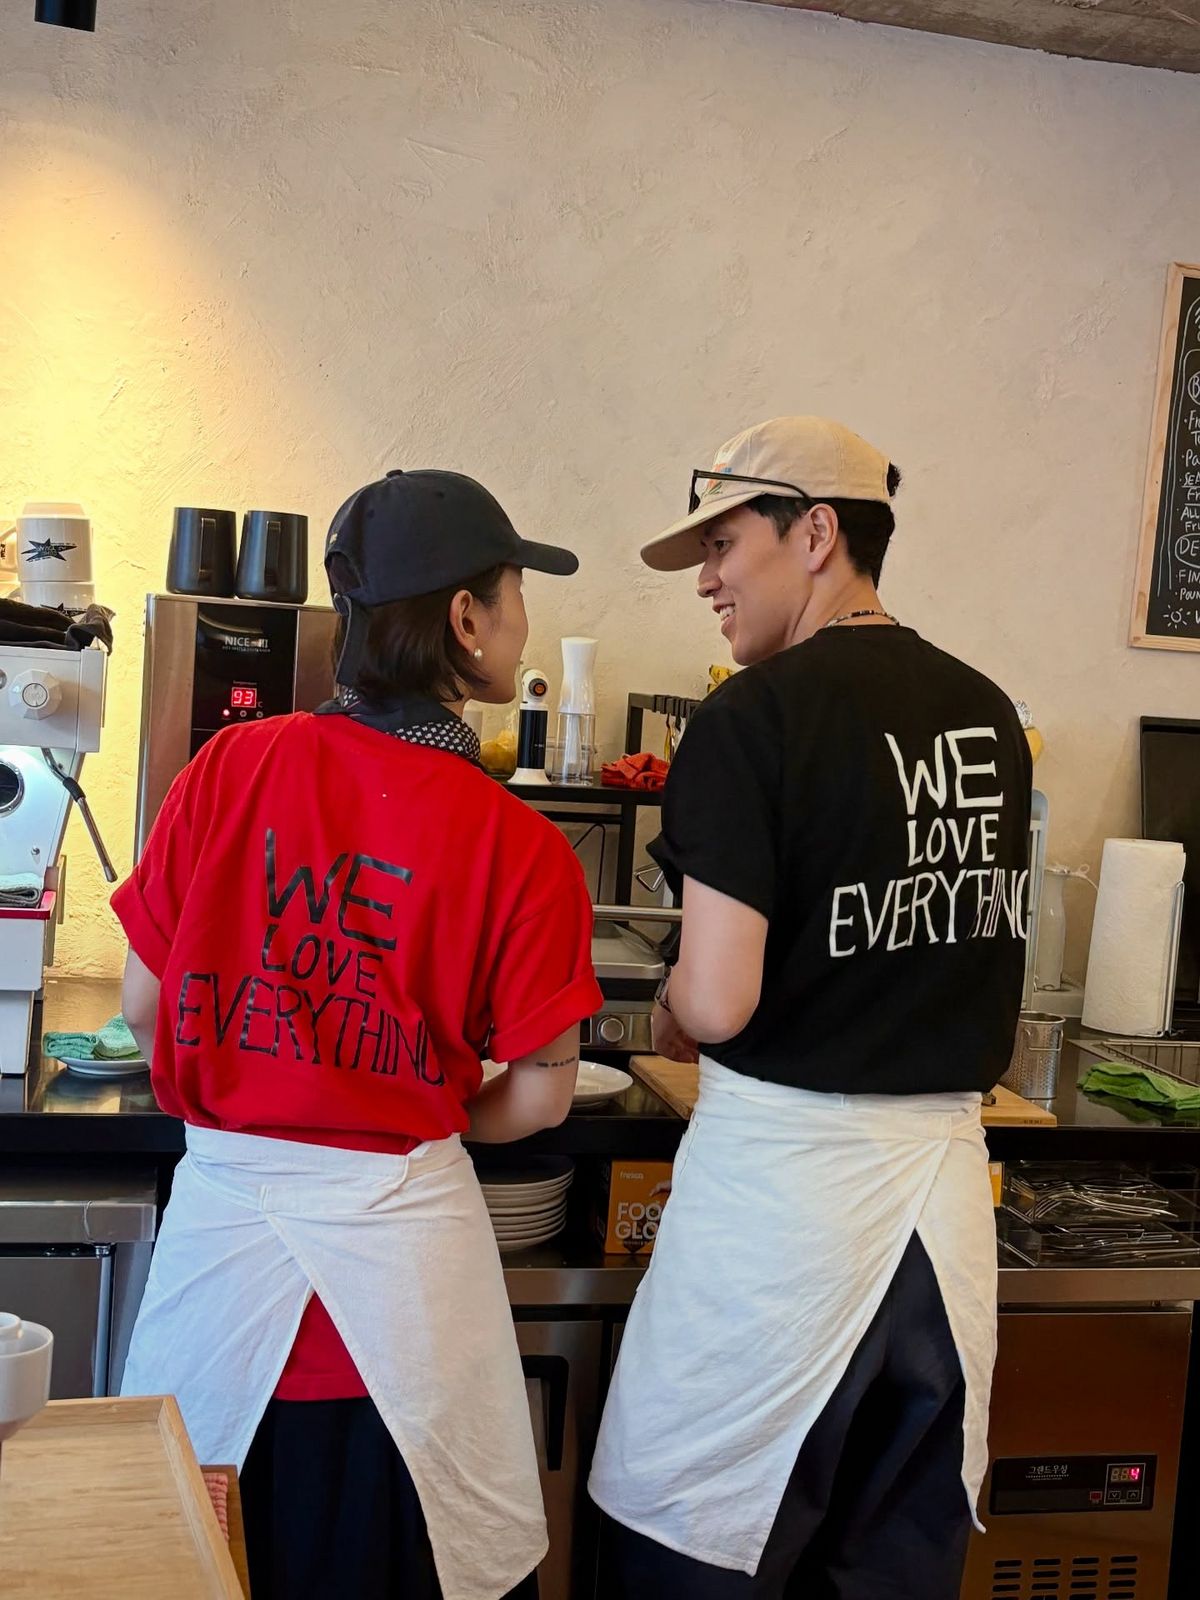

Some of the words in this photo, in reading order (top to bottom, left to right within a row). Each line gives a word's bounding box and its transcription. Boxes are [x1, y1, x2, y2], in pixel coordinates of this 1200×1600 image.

[233, 690, 254, 705] 93
[884, 726, 1004, 815] WE
[907, 813, 1000, 867] LOVE
[265, 827, 414, 951] WE
[261, 924, 384, 999] LOVE
